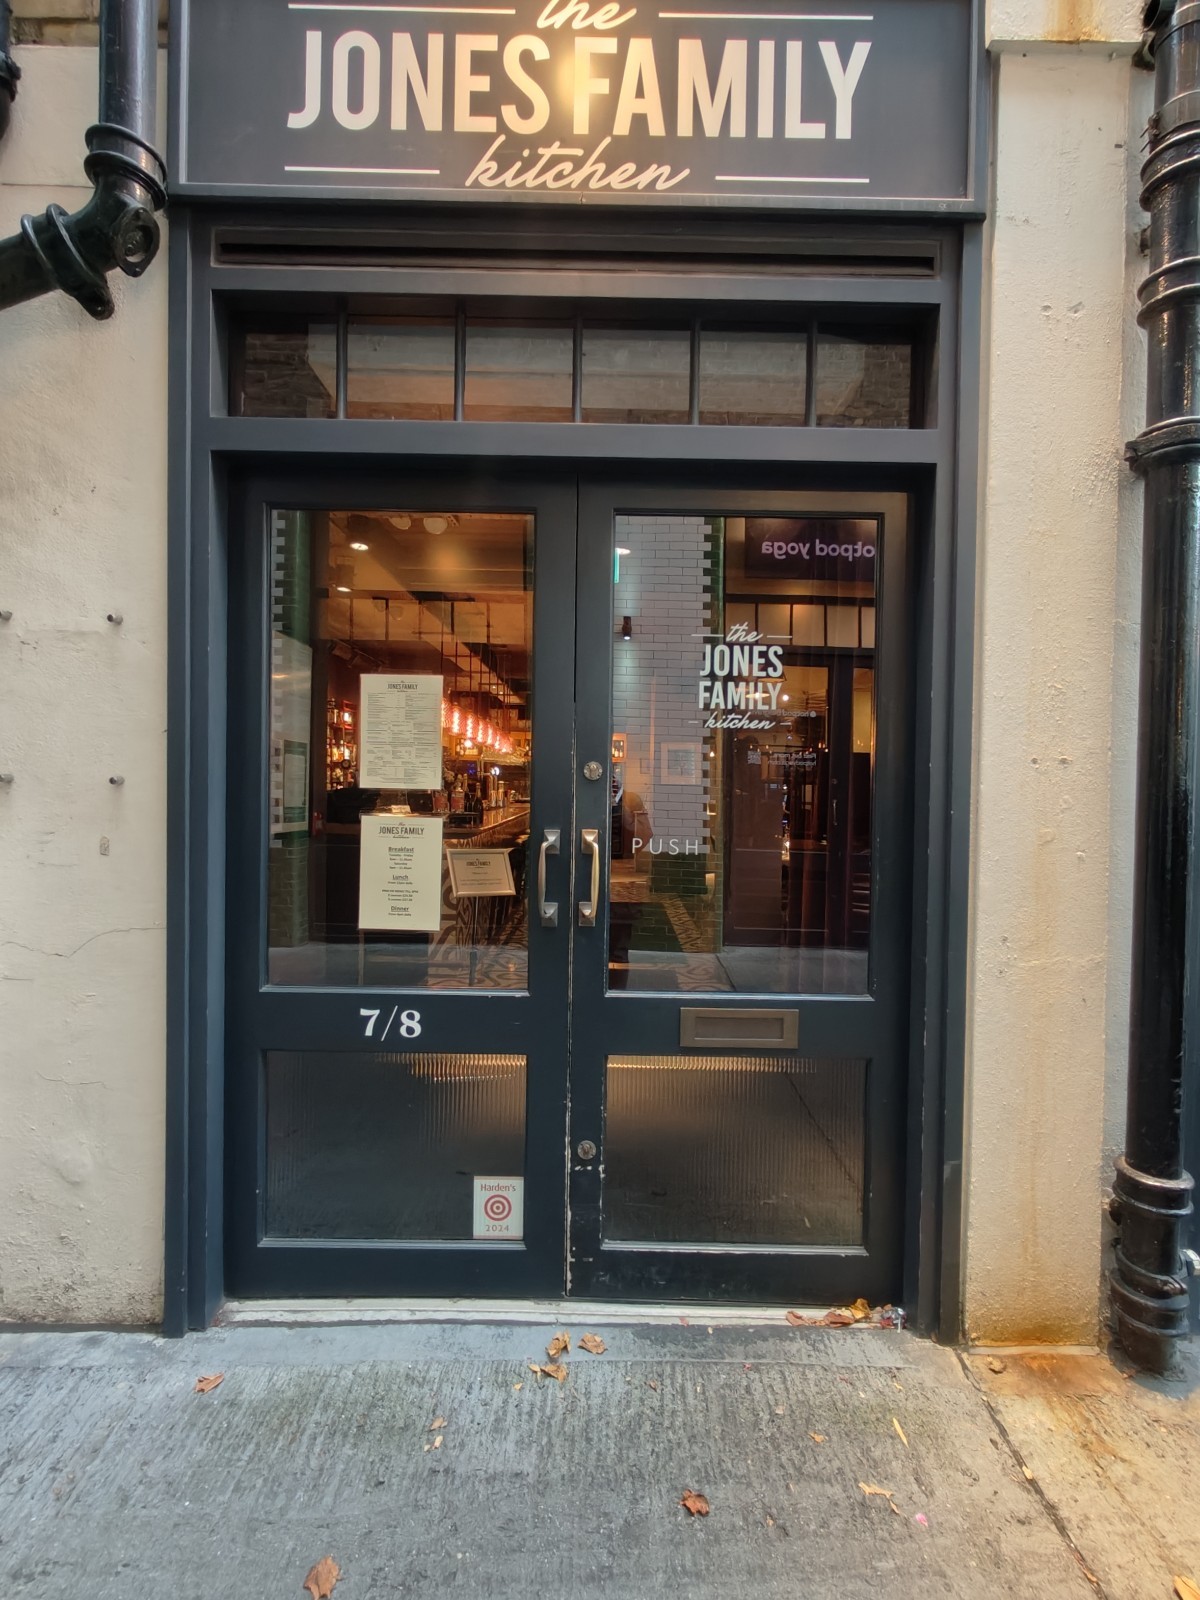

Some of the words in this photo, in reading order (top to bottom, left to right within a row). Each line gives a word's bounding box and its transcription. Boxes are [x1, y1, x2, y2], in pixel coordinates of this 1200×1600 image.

[535, 0, 638, 31] the
[286, 30, 551, 136] JONES
[573, 36, 872, 141] FAMILY
[464, 135, 691, 192] kitchen
[725, 621, 764, 643] the
[699, 644, 784, 678] JONES
[402, 683, 418, 691] FAMILY
[698, 680, 783, 711] FAMILY
[704, 711, 776, 730] kitchen
[378, 826, 400, 835] JONES
[400, 826, 425, 836] FAMILY
[631, 838, 699, 856] PUSH
[360, 1005, 422, 1042] 7/8
[480, 1183, 517, 1192] Harden's
[485, 1224, 509, 1232] 2024
